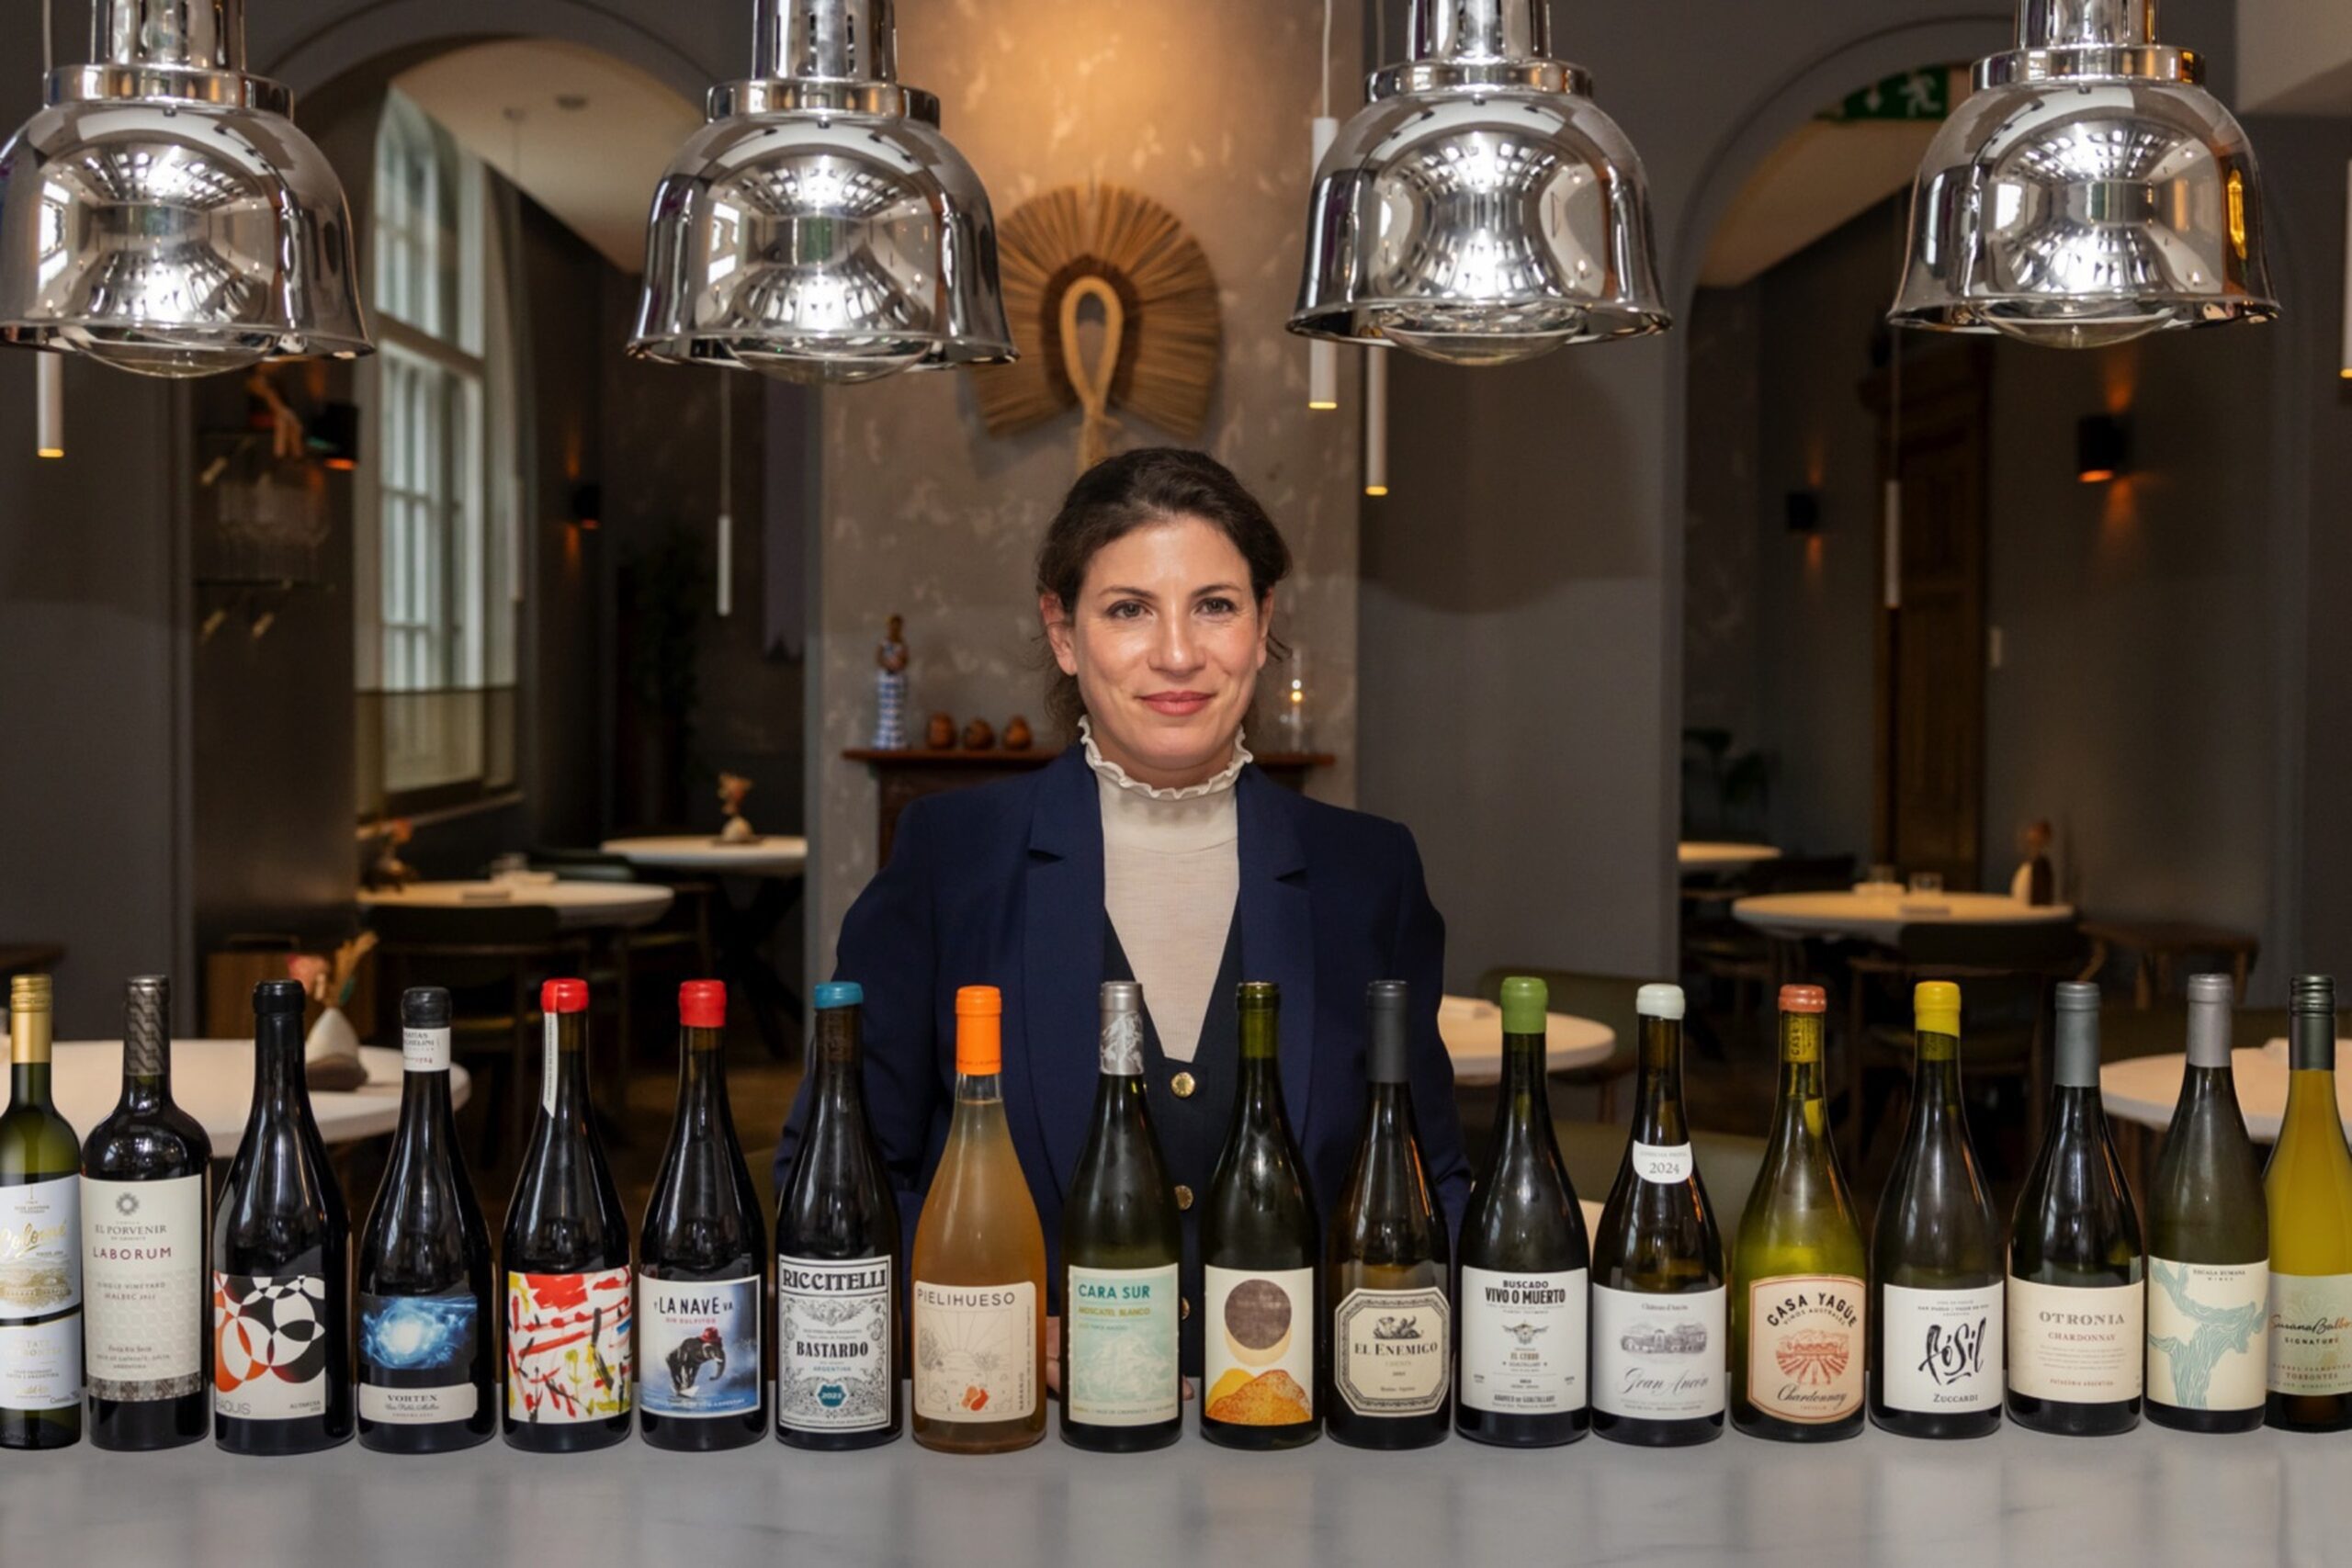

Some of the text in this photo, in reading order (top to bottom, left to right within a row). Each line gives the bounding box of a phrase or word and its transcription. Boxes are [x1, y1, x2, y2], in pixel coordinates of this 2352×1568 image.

[1649, 1162, 1679, 1175] 2024
[95, 1224, 167, 1235] EL PORVENIR
[93, 1247, 172, 1260] LABORUM
[125, 1281, 166, 1290] VINEYARD
[782, 1269, 886, 1292] RICCITELLI
[1503, 1280, 1549, 1289] BUSCADO
[917, 1288, 1015, 1307] PIELIHUESO
[1078, 1284, 1151, 1299] CARA SUR
[1485, 1287, 1566, 1304] VIVO O MUERTO
[659, 1296, 676, 1314] LA
[680, 1297, 721, 1314] NAVE
[723, 1302, 733, 1312] VA
[1078, 1306, 1151, 1316] MOSCATEL BLANCO
[1767, 1292, 1857, 1327] CASA YAGÜE
[1783, 1307, 1846, 1325] VINOS AUSTRALES
[2039, 1311, 2125, 1325] OTRONIA
[2048, 1332, 2116, 1341] CHARDONNAY
[796, 1340, 869, 1359] BASTARDO
[1354, 1342, 1438, 1356] EL ENEMIGO
[386, 1394, 438, 1403] VORTEX
[1777, 1383, 1849, 1410] Chardonnay
[1933, 1393, 1978, 1403] ZUCCARDI
